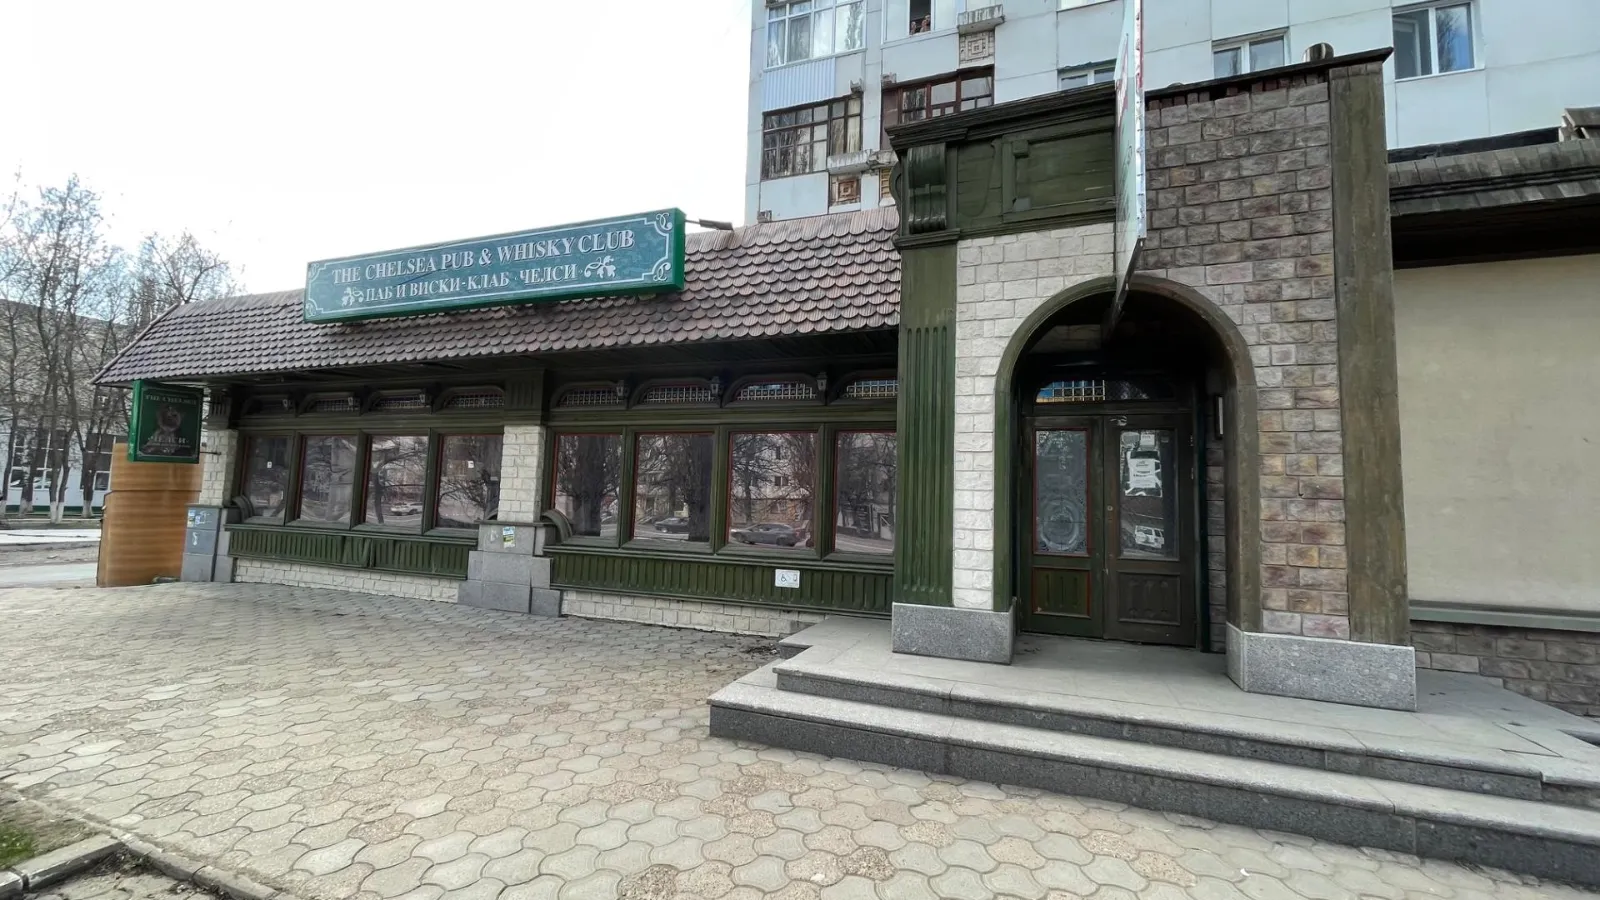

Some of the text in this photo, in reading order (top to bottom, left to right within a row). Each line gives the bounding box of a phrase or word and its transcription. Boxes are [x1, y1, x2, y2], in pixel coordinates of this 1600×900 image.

[332, 229, 635, 284] THE CHELSEA PUB & WHISKY CLUB
[366, 286, 393, 301] ПАБ
[396, 284, 406, 298] И
